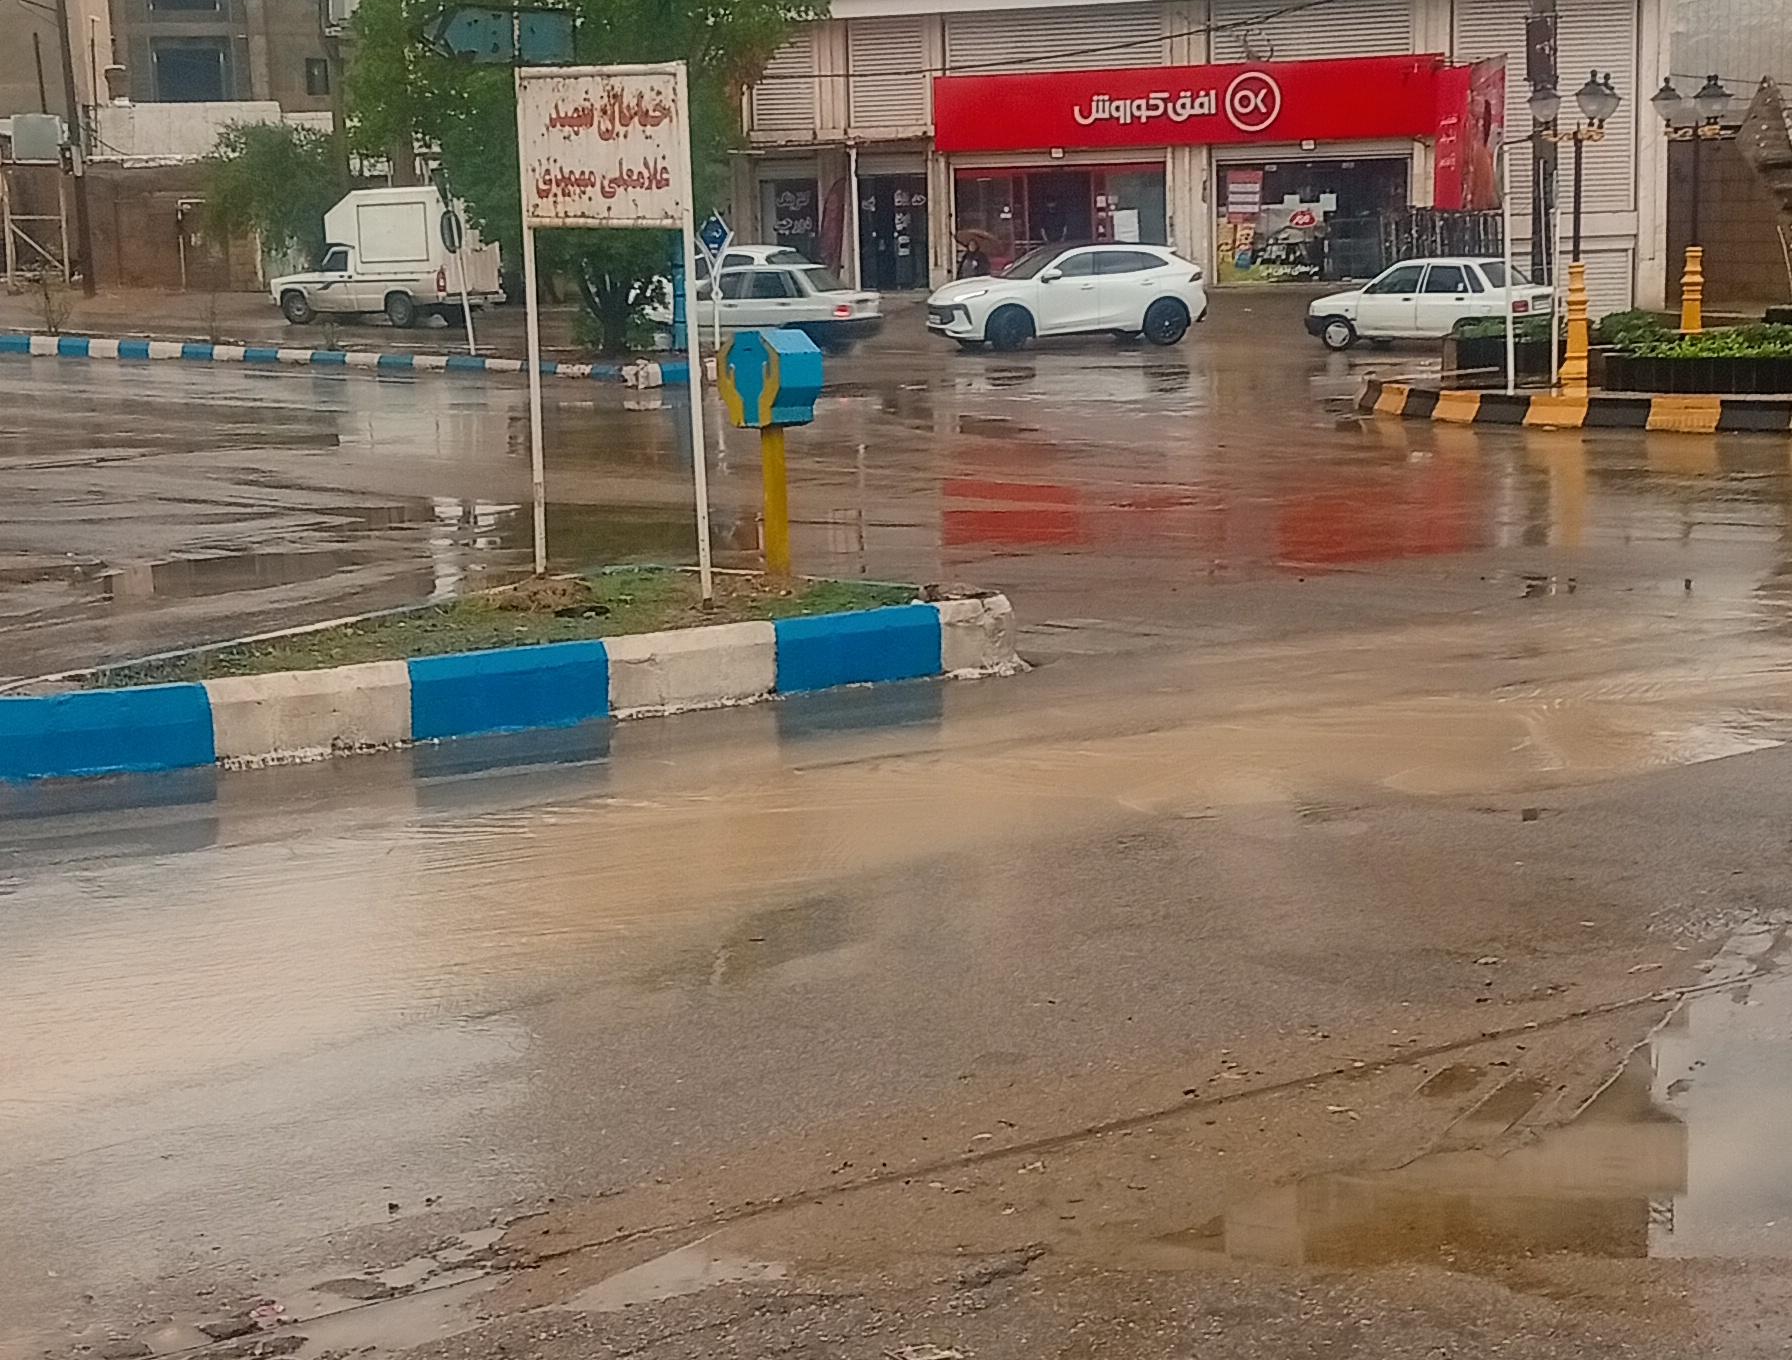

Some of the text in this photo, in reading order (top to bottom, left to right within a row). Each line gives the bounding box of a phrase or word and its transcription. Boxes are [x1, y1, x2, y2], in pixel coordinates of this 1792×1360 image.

[548, 90, 594, 140] شهید
[1073, 89, 1217, 126] افق کوروش
[600, 155, 670, 199] غلامعلی
